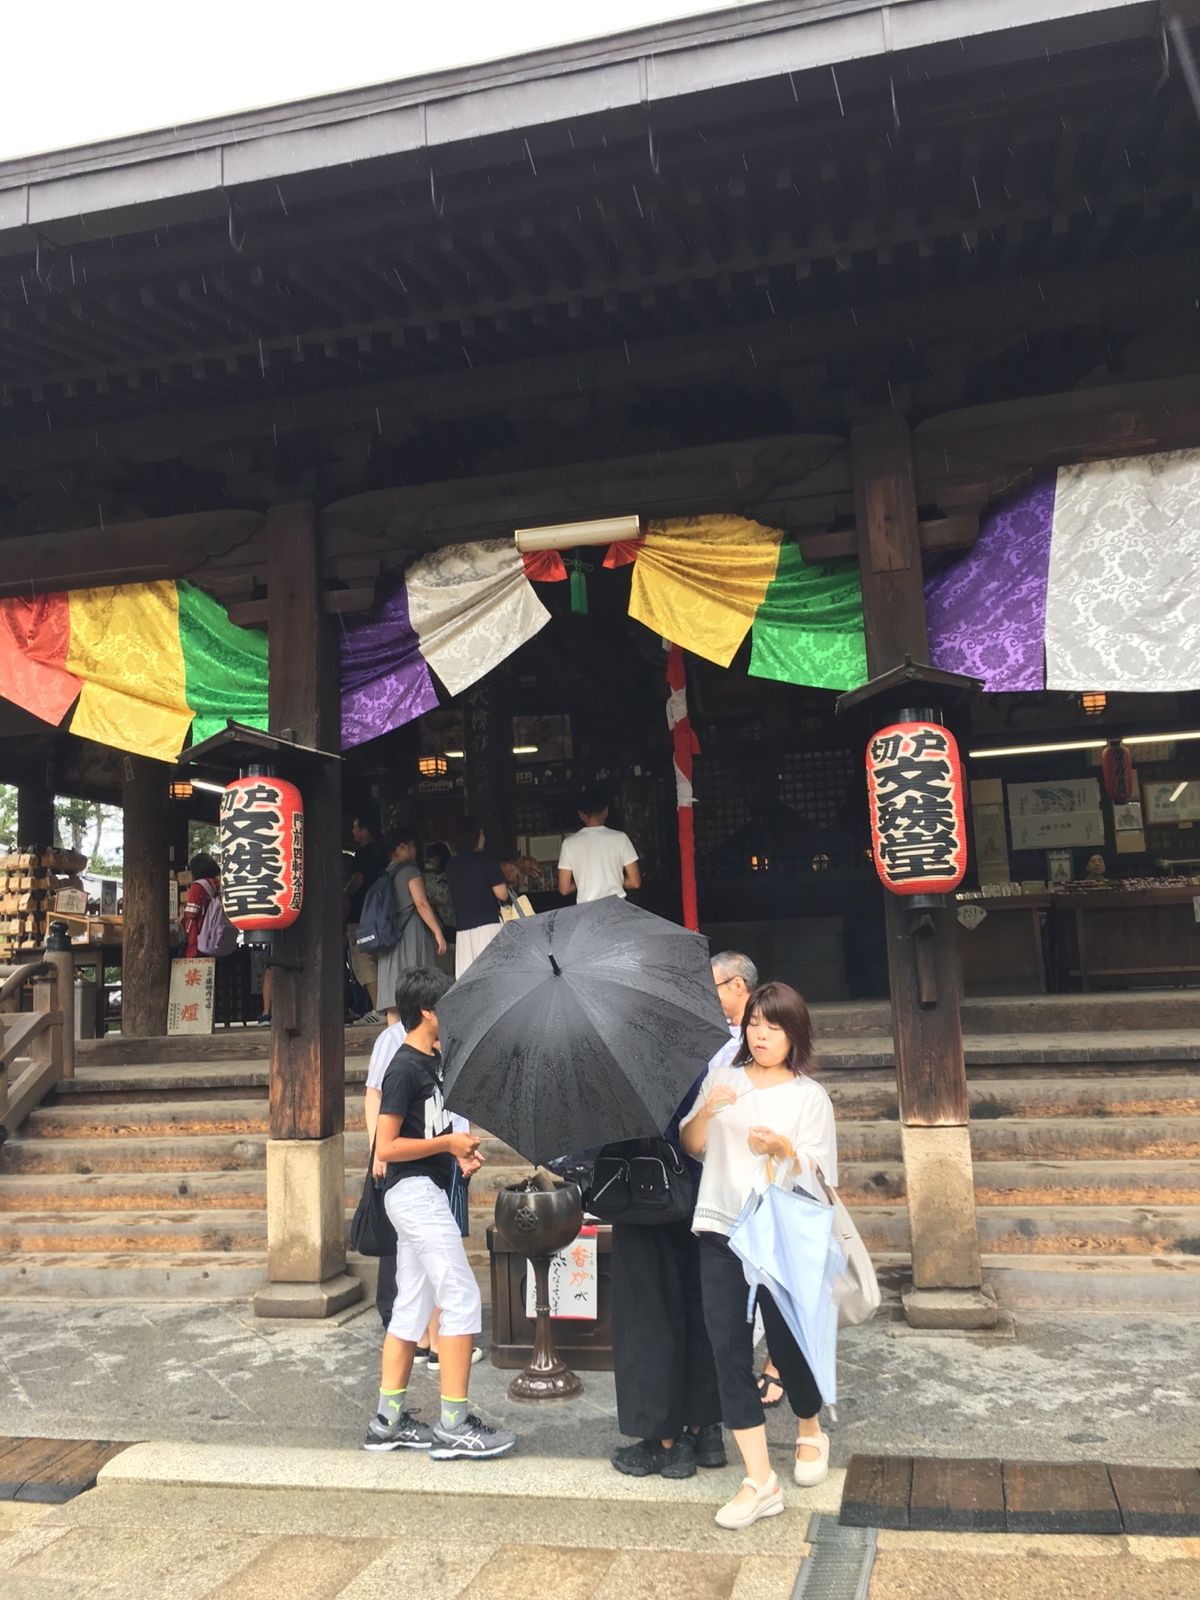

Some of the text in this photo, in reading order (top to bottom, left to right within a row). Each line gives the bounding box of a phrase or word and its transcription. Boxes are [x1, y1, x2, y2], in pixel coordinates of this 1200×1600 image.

[221, 808, 284, 917] 文殊堂
[873, 757, 958, 881] 文殊堂
